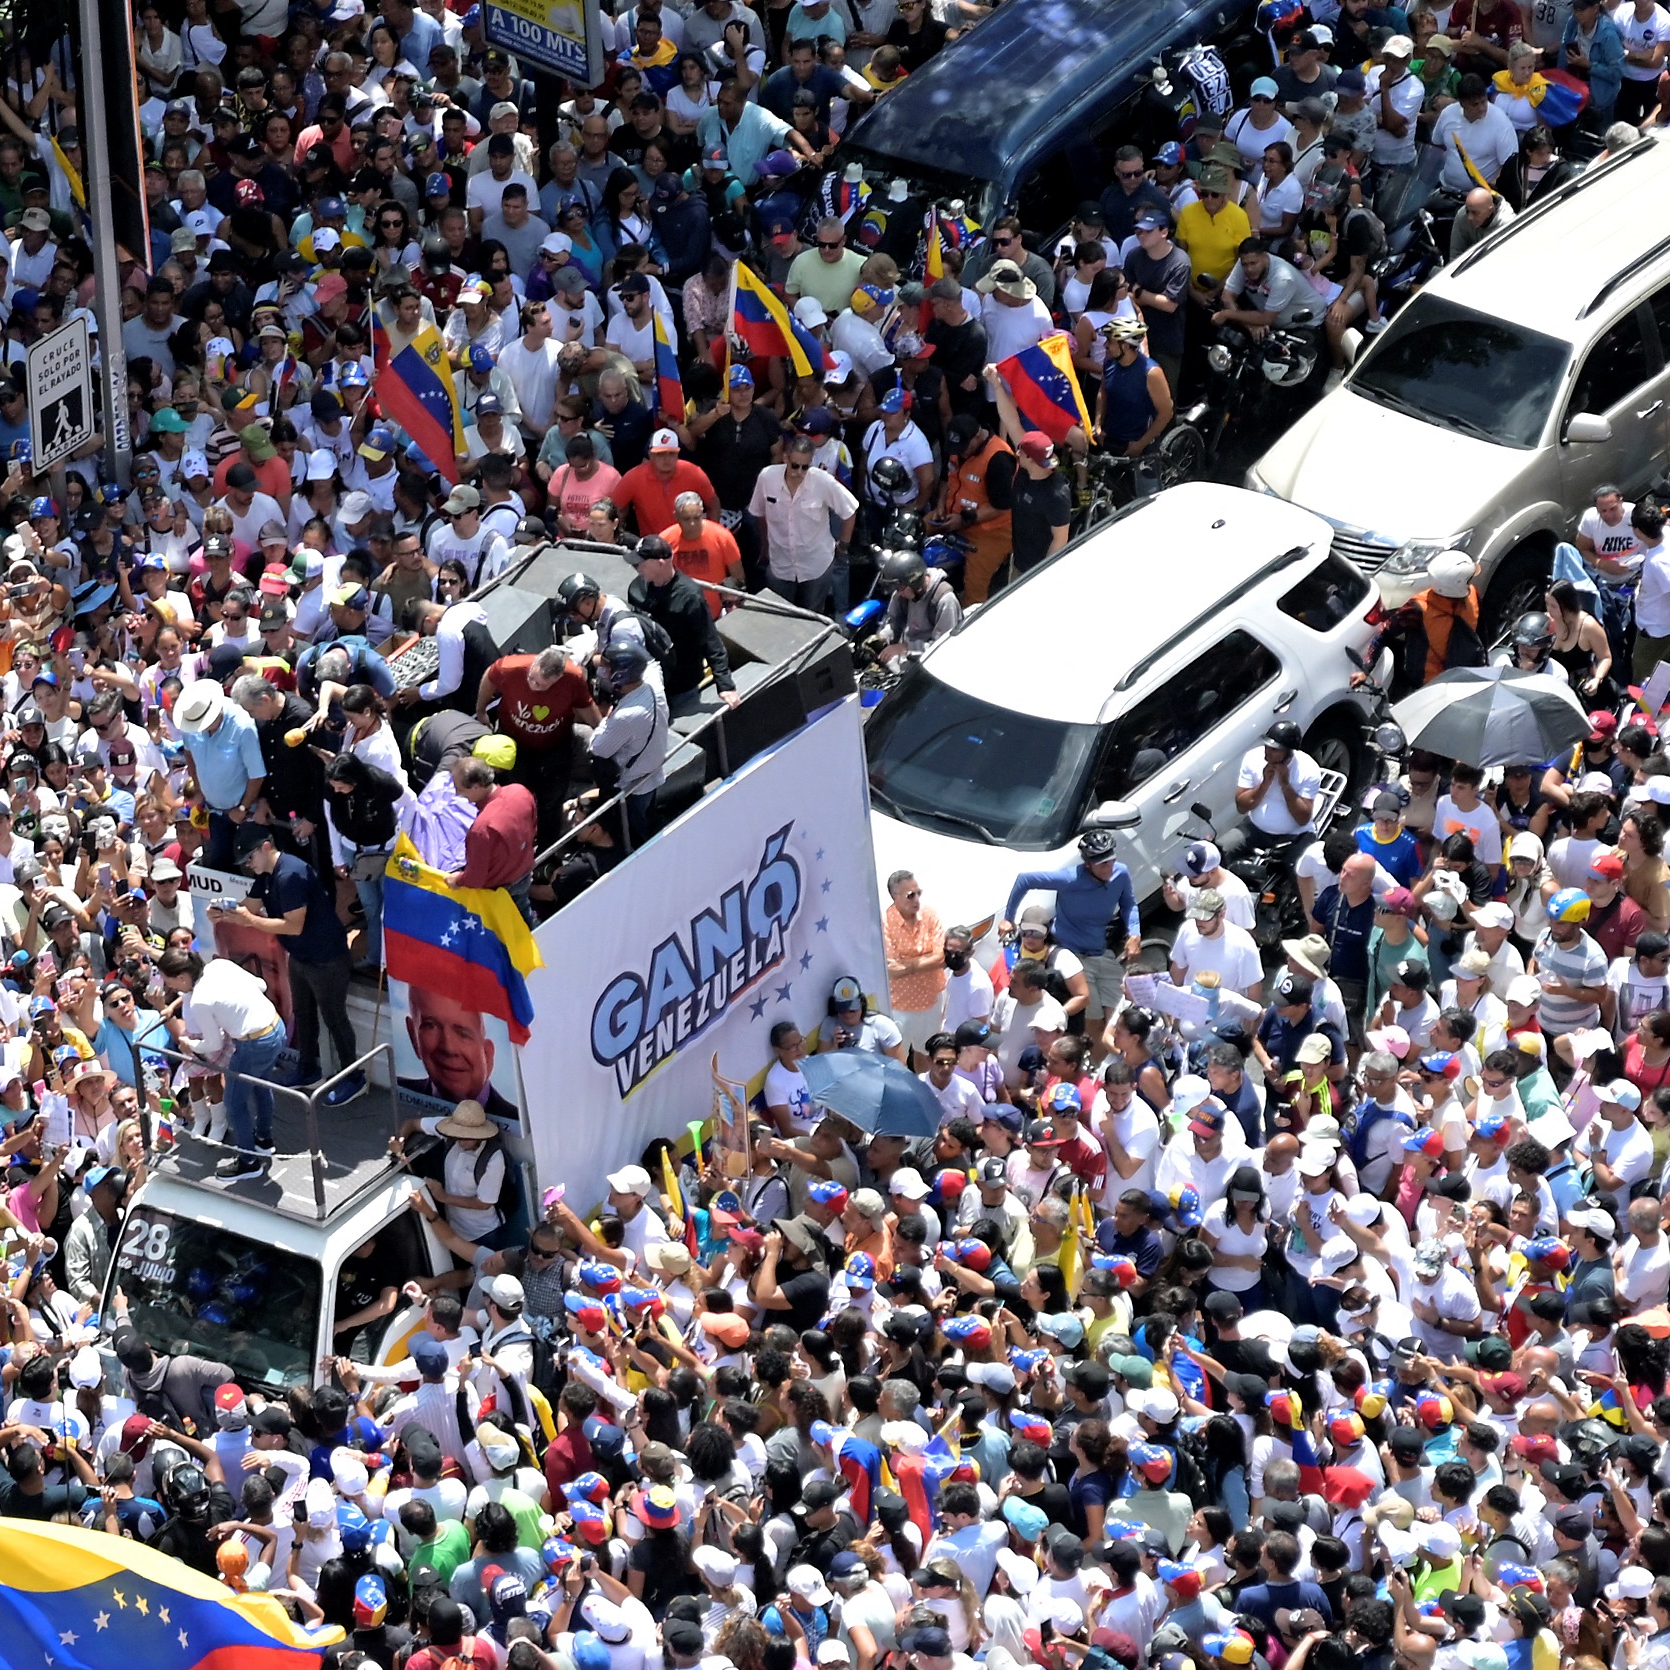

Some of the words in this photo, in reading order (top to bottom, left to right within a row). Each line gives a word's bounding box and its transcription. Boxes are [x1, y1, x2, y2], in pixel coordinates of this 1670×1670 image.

[491, 8, 505, 28] A
[510, 16, 542, 43] 100
[546, 31, 587, 62] MTS
[38, 360, 61, 383] SOLO
[63, 349, 81, 369] POR
[43, 338, 75, 365] CRUCE
[38, 380, 50, 396] EL
[51, 363, 82, 390] RAYADO
[1601, 536, 1635, 553] NIKE
[516, 700, 531, 719] Yo
[591, 820, 803, 1071] GANÓ
[614, 918, 791, 1098] VENEZUELA
[399, 1092, 452, 1113] EDMUNDO
[122, 1218, 170, 1262] 28
